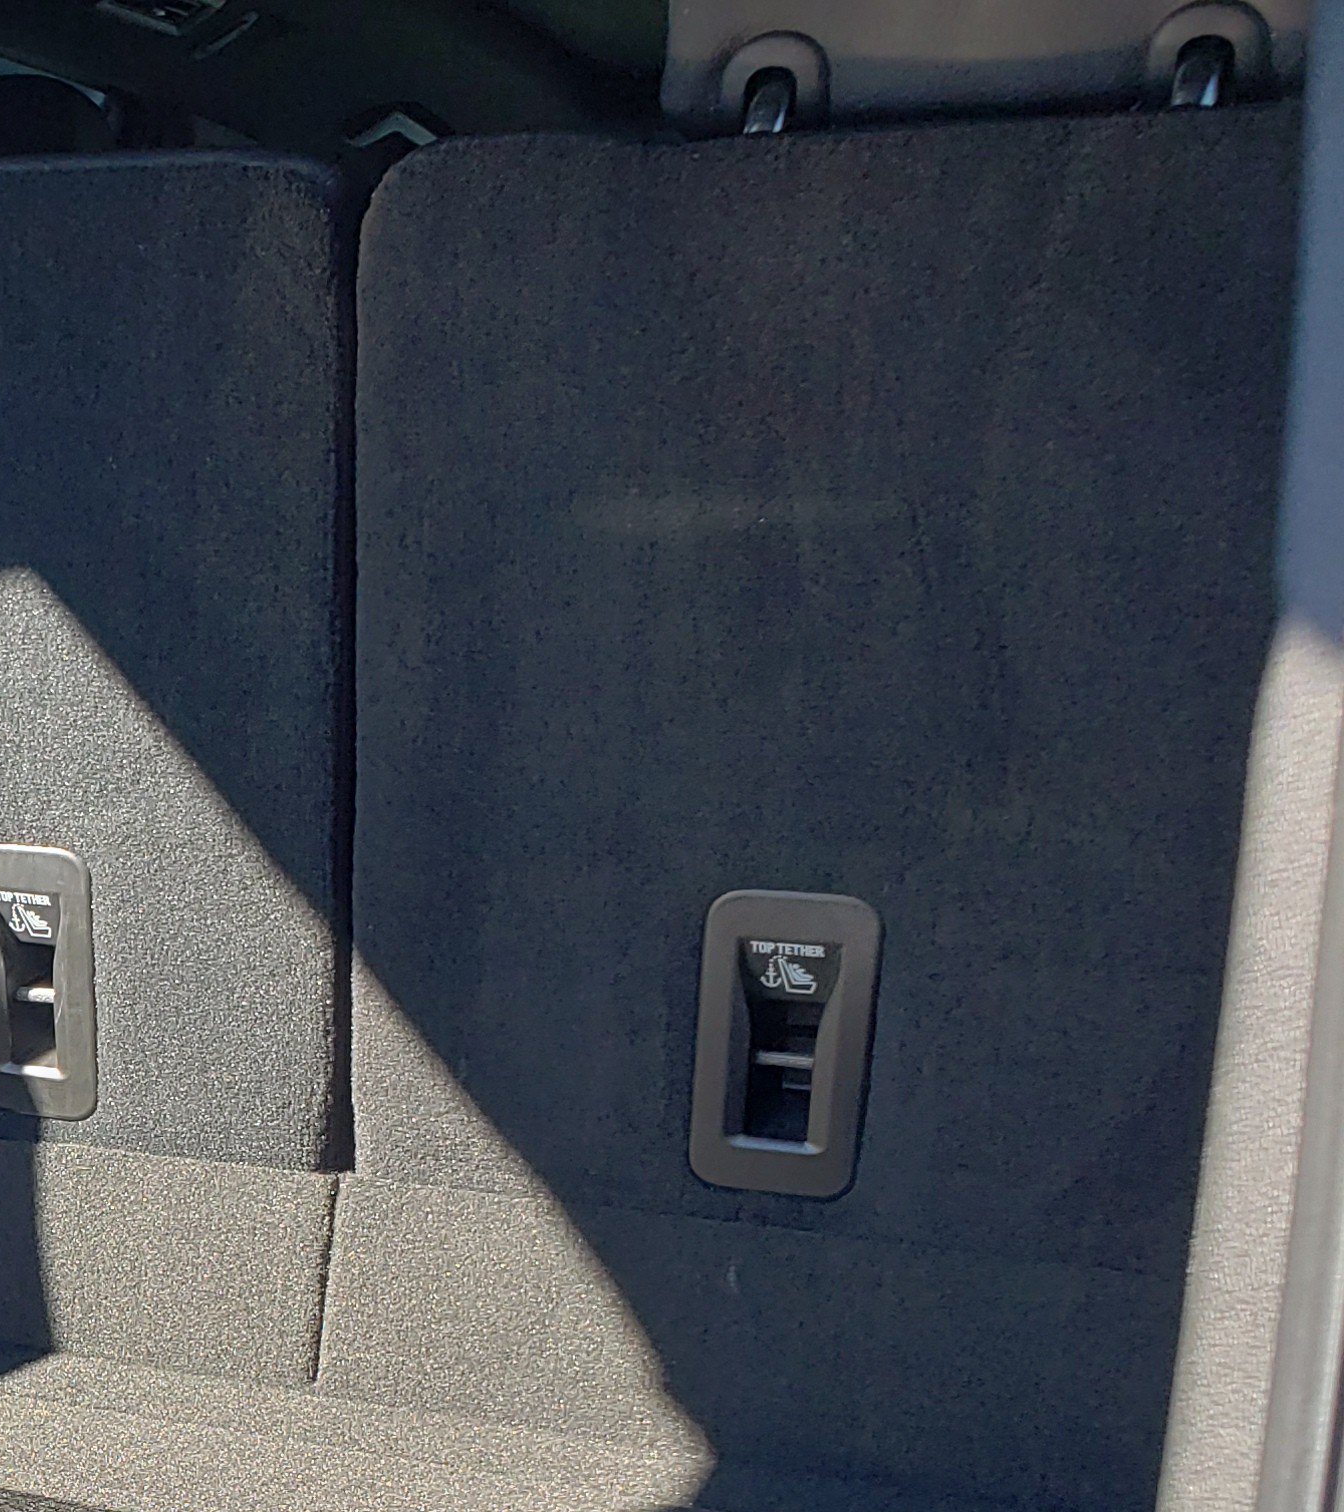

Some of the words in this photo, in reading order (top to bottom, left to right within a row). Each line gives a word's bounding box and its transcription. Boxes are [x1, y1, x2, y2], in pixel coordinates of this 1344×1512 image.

[13, 892, 51, 906] TETHER
[750, 940, 775, 954] TOP
[776, 942, 825, 958] TETHER
